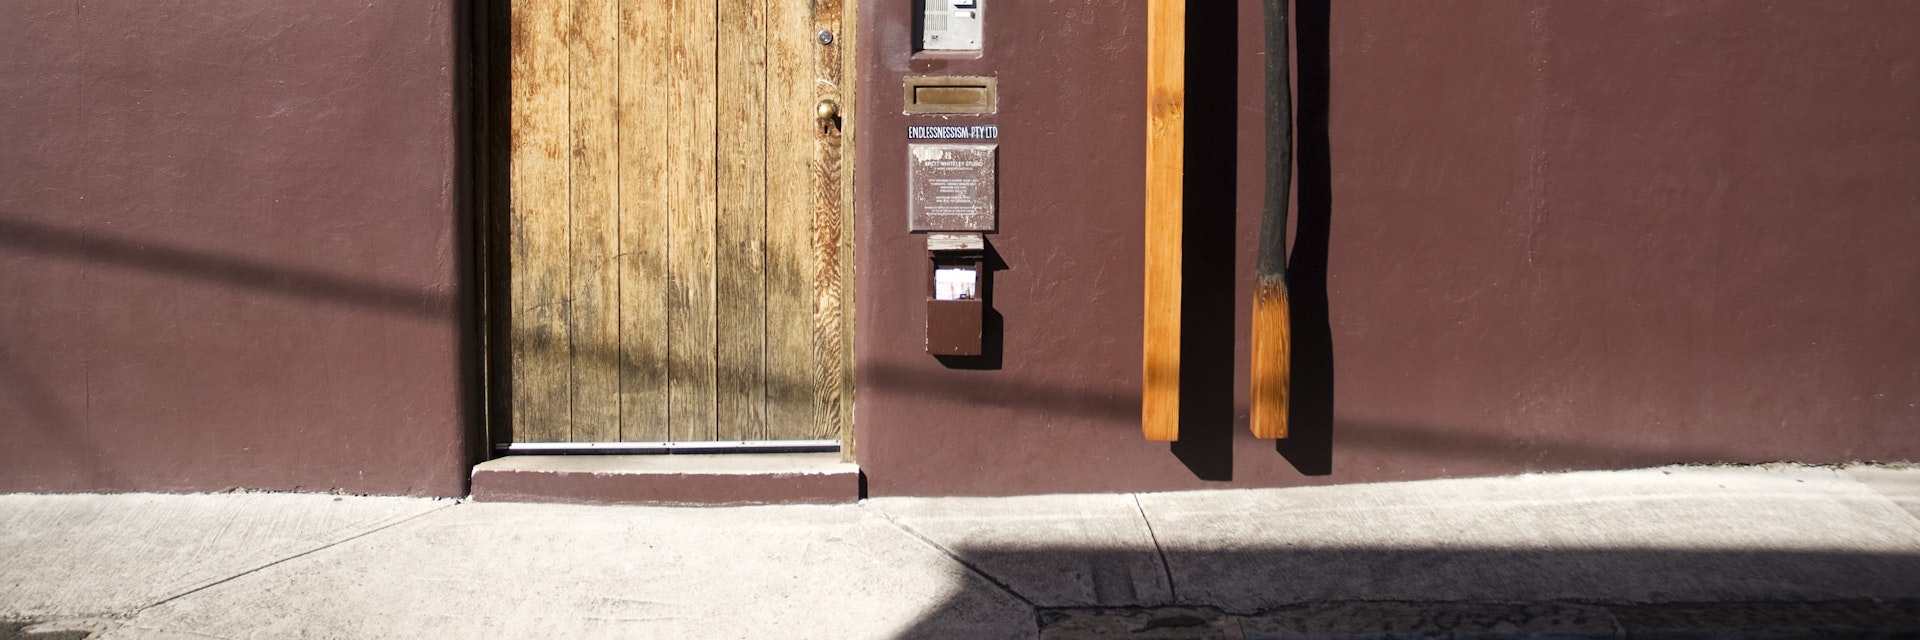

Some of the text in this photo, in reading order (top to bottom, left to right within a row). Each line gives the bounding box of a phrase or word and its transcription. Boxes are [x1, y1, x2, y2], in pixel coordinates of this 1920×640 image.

[908, 126, 998, 139] ENDLESSNESSISM PTY LTD
